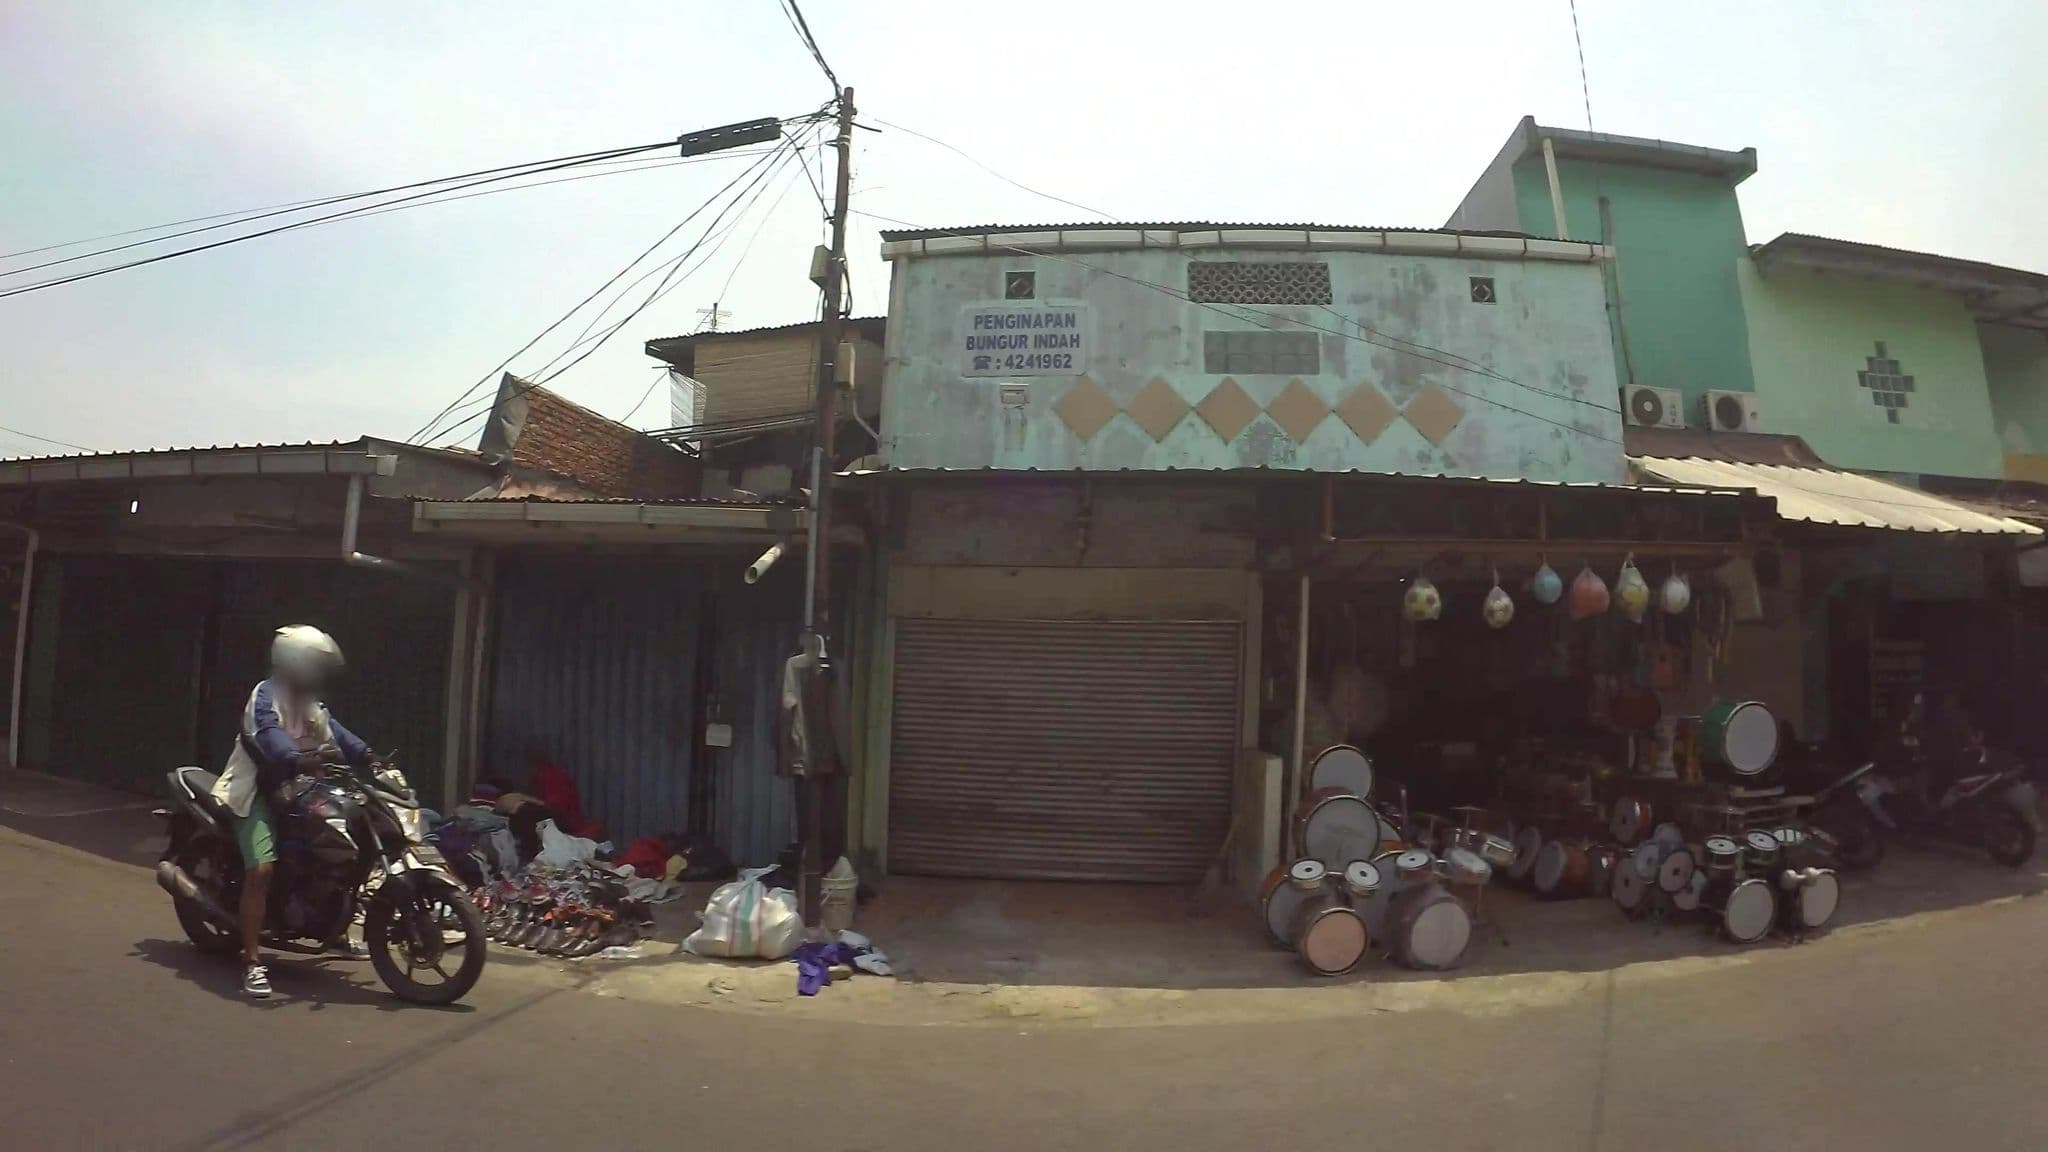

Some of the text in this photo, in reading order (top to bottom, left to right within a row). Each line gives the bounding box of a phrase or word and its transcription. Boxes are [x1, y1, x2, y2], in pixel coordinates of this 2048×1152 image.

[974, 313, 1076, 330] PENGINAPAN
[966, 333, 1080, 350] BUNGUR INDAH
